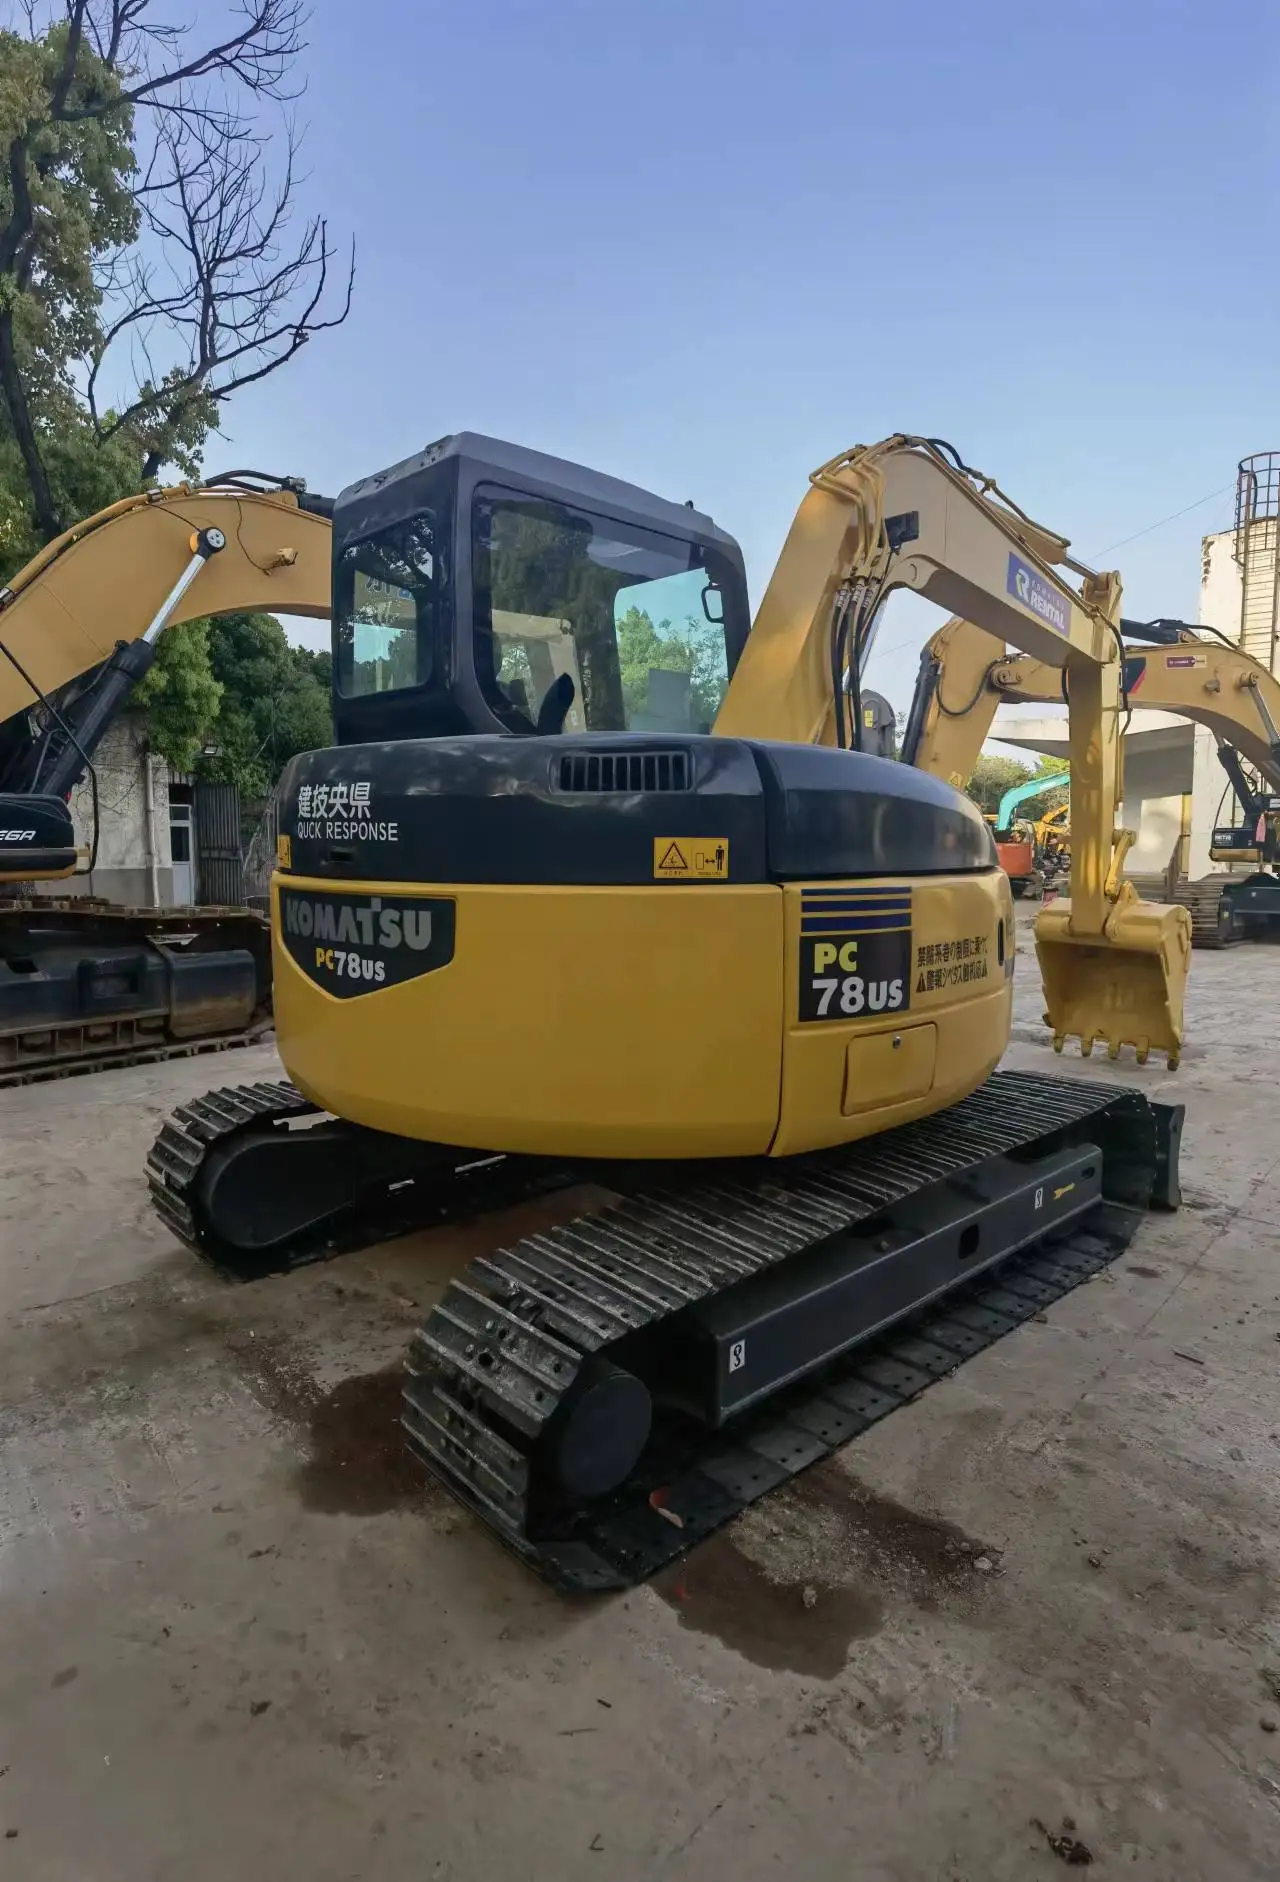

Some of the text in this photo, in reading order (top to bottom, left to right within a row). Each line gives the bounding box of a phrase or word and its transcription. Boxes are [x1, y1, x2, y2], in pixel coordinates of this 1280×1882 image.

[297, 821, 399, 841] QUCK RESPONSE
[286, 897, 432, 951] KOMATSU
[814, 941, 858, 974] PC
